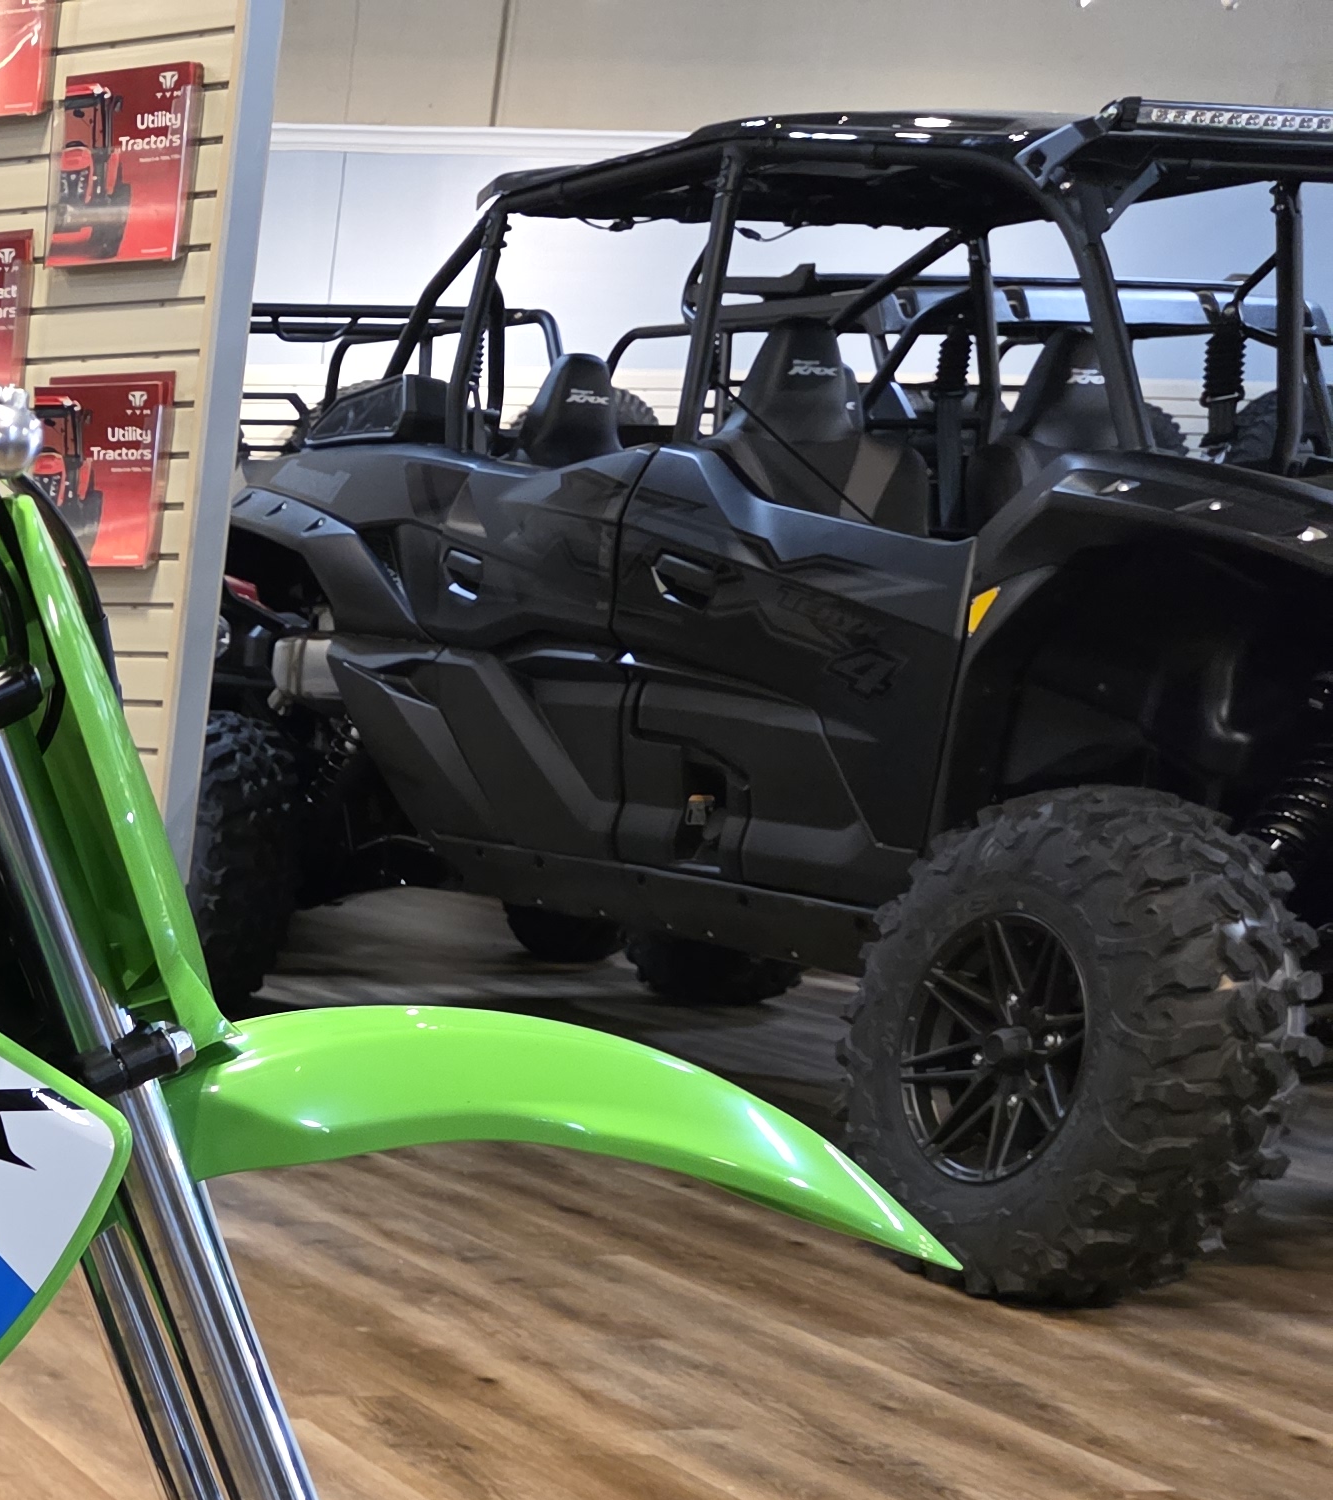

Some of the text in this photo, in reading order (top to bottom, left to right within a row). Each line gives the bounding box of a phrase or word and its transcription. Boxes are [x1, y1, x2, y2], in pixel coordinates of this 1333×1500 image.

[136, 110, 182, 130] Utility
[118, 134, 181, 151] Tractors
[107, 426, 152, 444] Utility
[90, 446, 152, 461] Tractors
